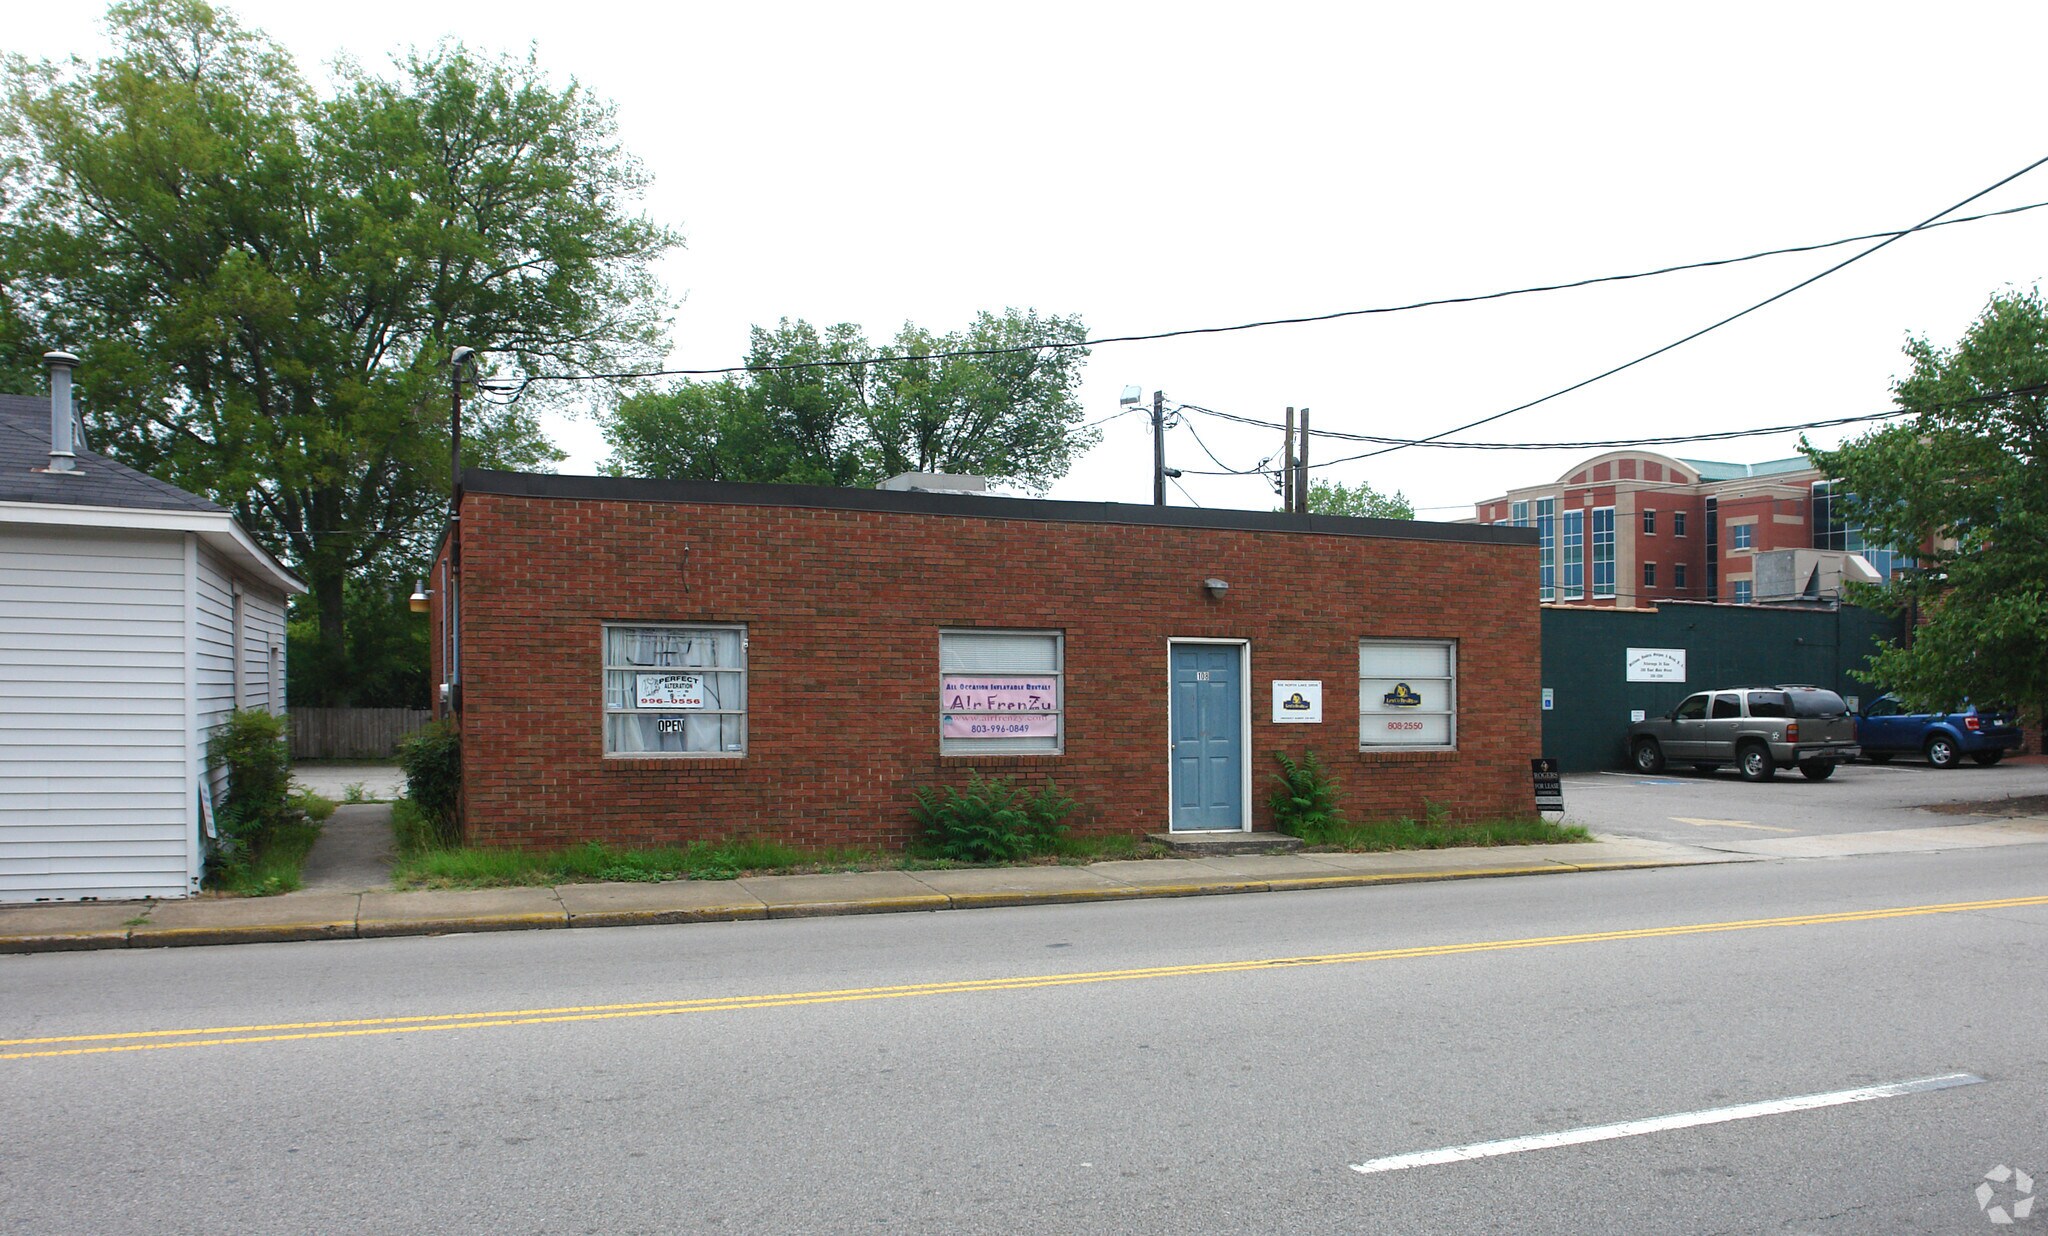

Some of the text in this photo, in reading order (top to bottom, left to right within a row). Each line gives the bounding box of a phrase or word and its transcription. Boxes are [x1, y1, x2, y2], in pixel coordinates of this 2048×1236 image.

[659, 676, 698, 684] PERFECT
[658, 719, 684, 731] OPEN
[971, 725, 1030, 733] 803-996-0849
